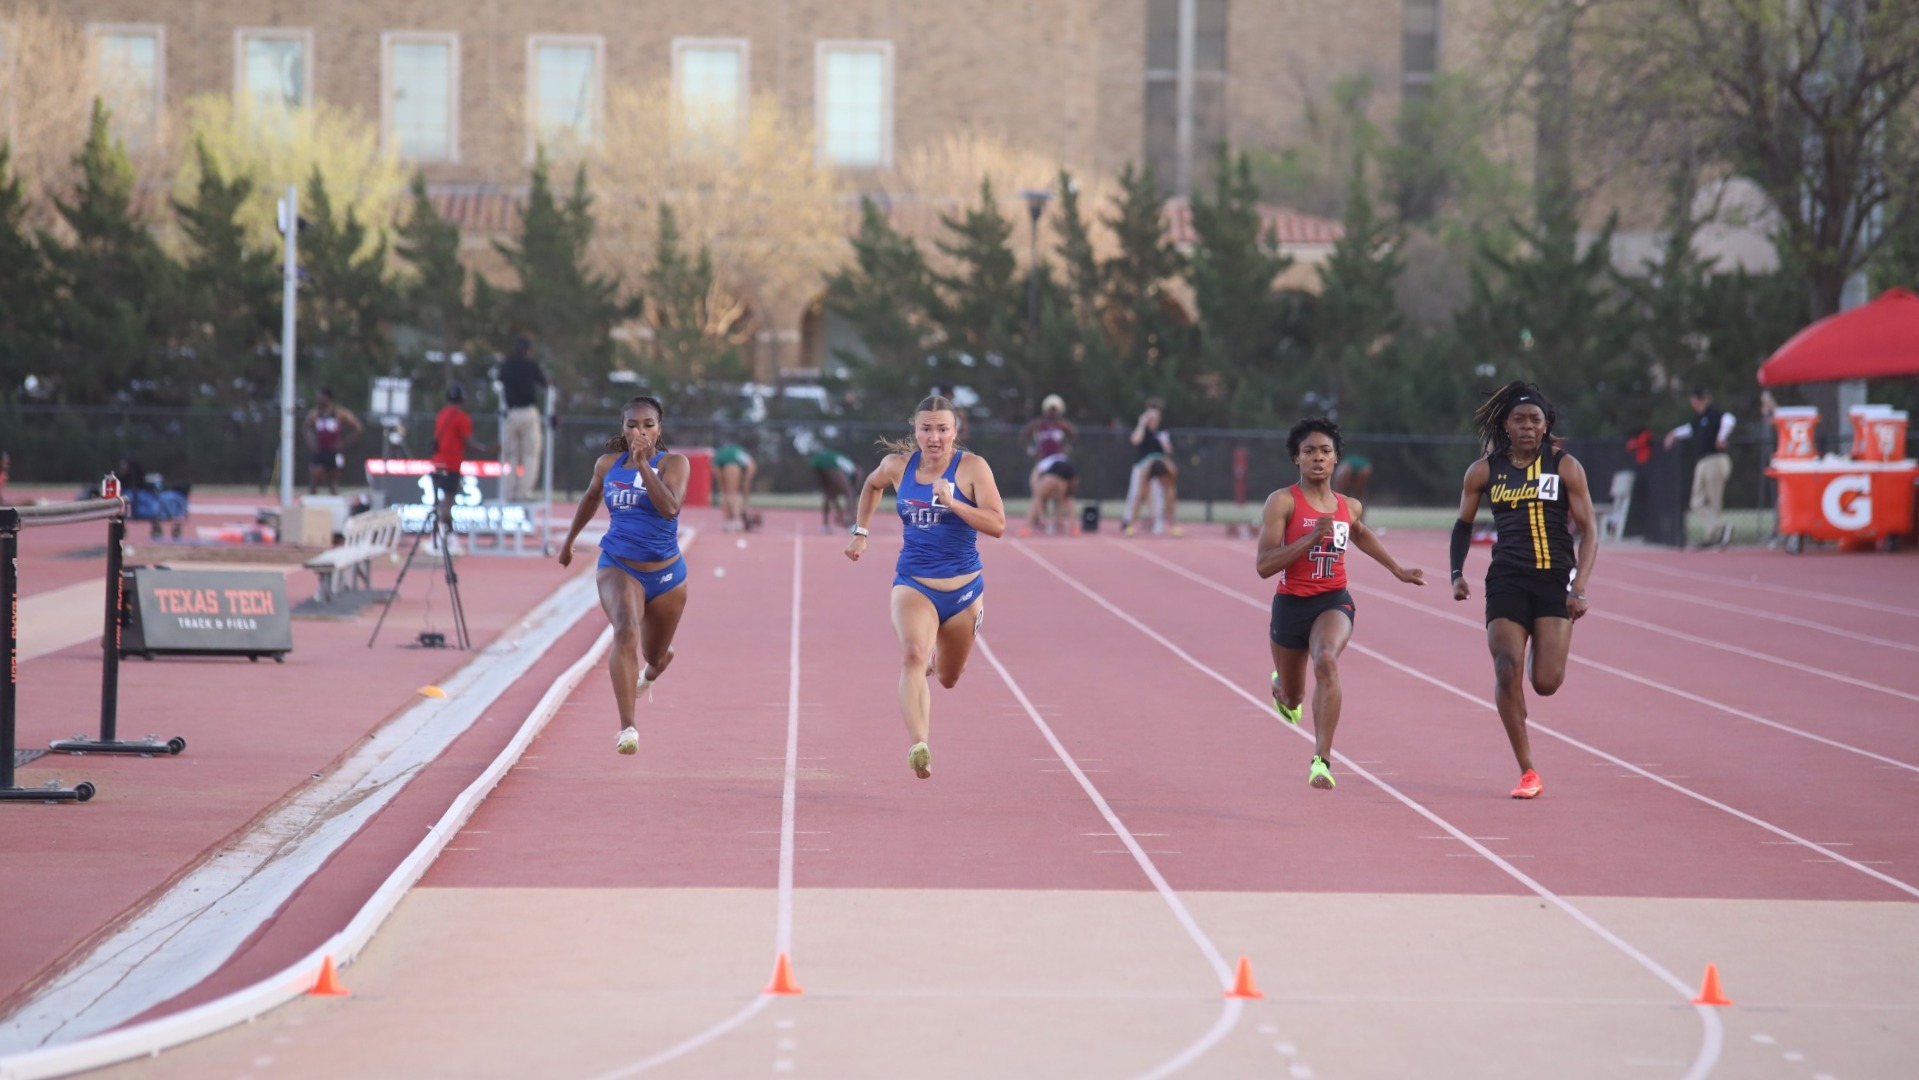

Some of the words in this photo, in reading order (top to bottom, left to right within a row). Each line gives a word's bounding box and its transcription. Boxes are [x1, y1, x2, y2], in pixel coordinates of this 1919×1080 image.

[1541, 476, 1556, 498] 4
[1821, 474, 1872, 530] G
[1336, 523, 1347, 547] 3
[153, 587, 219, 614] TEXAS
[224, 589, 275, 615] TECH
[177, 617, 212, 629] TRACK
[226, 618, 257, 630] FIELD
